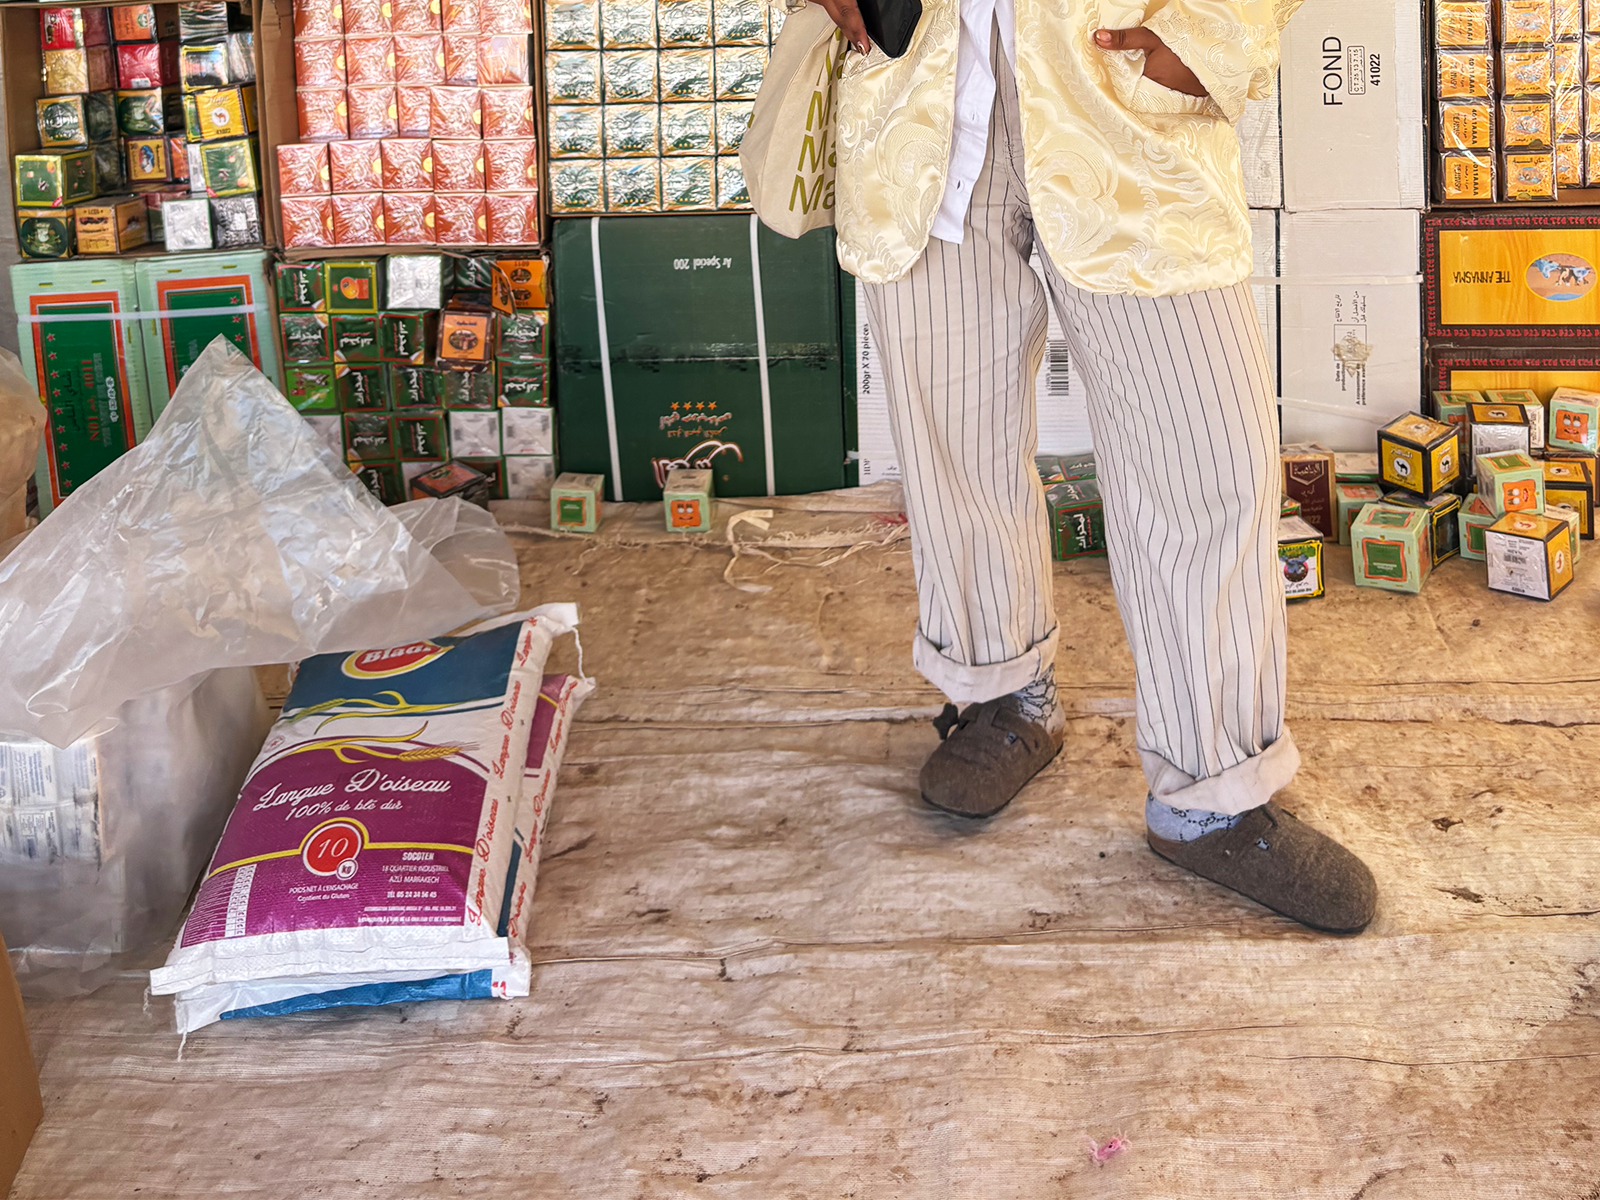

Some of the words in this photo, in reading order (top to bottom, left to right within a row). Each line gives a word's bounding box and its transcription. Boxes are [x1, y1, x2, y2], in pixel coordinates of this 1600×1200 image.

[1322, 36, 1343, 106] FOND
[1369, 53, 1381, 86] 41022
[673, 258, 690, 270] 200
[693, 256, 721, 271] Special
[721, 257, 732, 268] Ar
[1452, 271, 1493, 283] ANNASMA
[1495, 271, 1511, 283] THE
[862, 350, 869, 362] 70
[862, 368, 871, 394] 200gr
[252, 782, 335, 811] Langue
[344, 768, 452, 793] D'oiseau
[285, 801, 332, 821] 100%
[334, 801, 351, 812] de
[354, 799, 376, 811] blé
[380, 799, 404, 811] dur
[476, 799, 498, 862] D'oiseau
[317, 837, 350, 859] 10
[341, 865, 352, 875] kg
[467, 868, 486, 926] Langue
